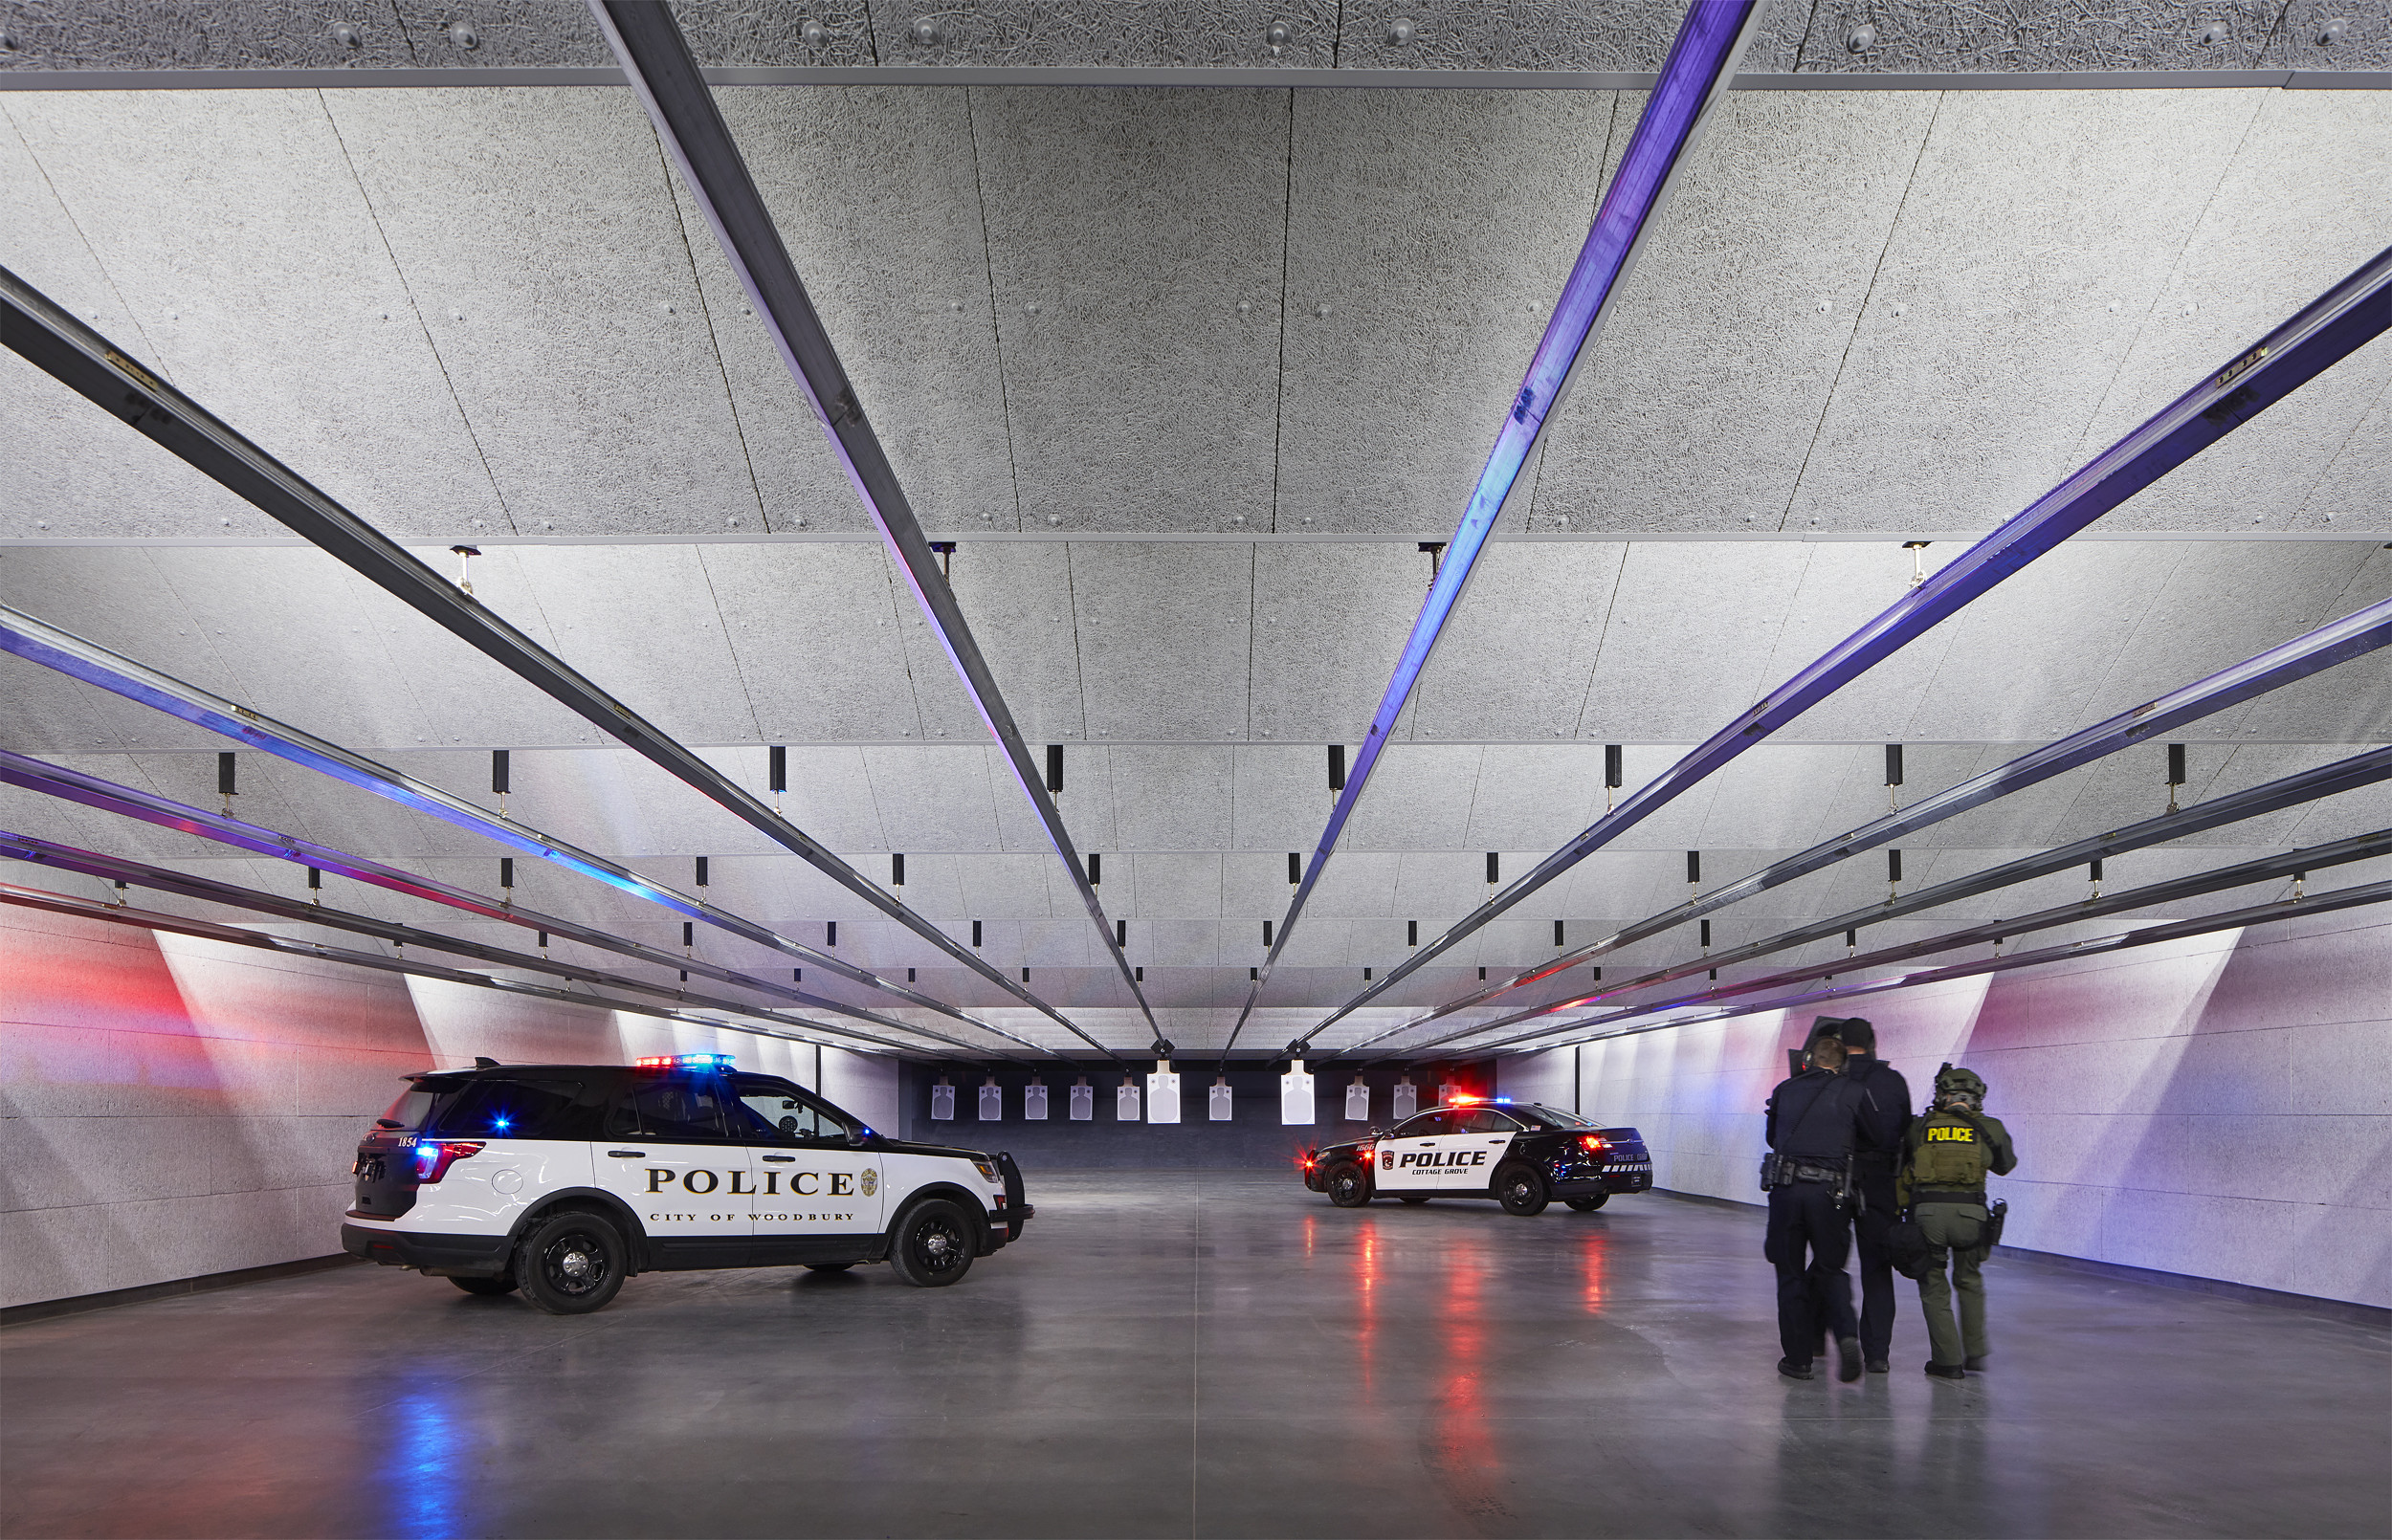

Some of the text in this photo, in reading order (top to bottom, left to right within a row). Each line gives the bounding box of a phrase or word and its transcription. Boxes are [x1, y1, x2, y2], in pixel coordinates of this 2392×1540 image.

[1927, 1126, 1974, 1142] POLICE
[397, 1136, 418, 1148] 1854
[1399, 1151, 1488, 1168] POLICE
[1613, 1154, 1634, 1162] POLICE
[644, 1168, 854, 1197] POLICE
[650, 1213, 854, 1221] CITY OF WOODBURY
